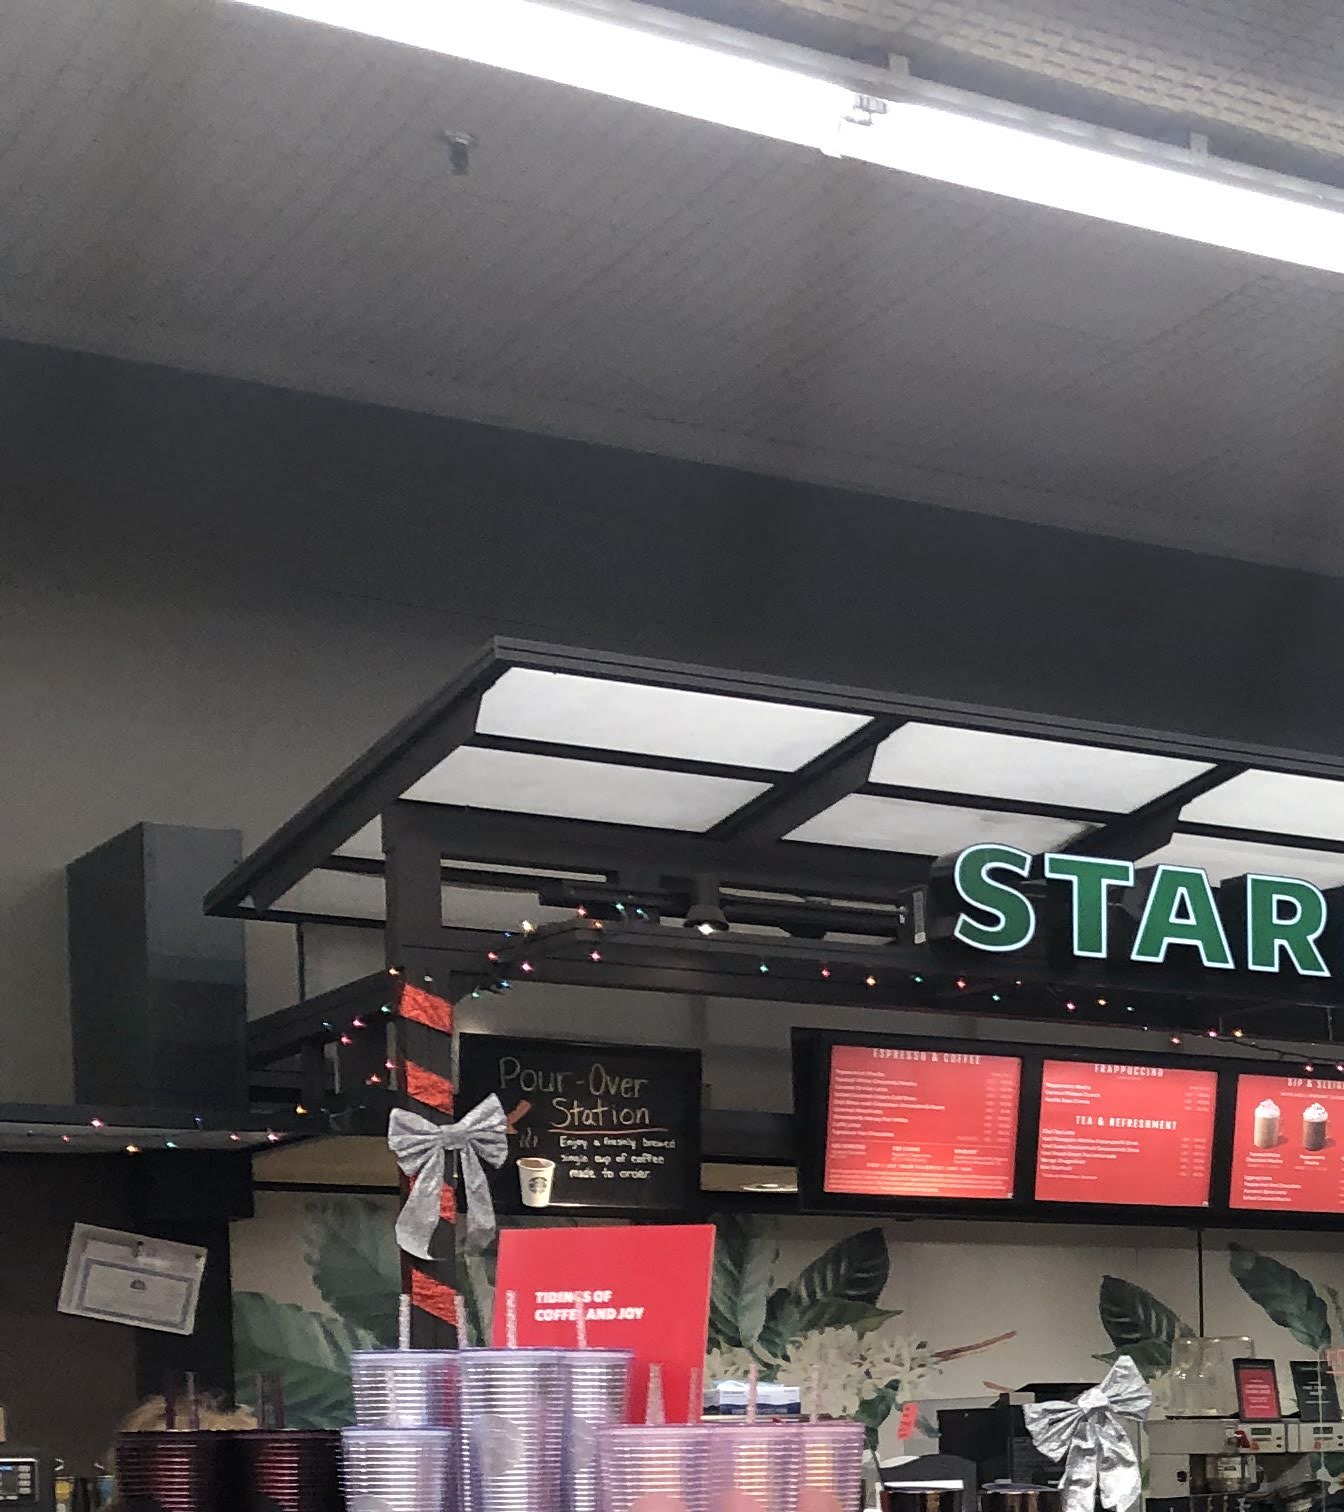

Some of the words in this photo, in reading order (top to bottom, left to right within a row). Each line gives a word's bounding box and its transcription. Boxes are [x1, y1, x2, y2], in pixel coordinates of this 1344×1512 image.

[873, 1048, 927, 1061] ESPRESSO
[943, 1053, 982, 1065] COFFEE
[1094, 1064, 1164, 1077] FRAPPUCCINO
[1287, 1078, 1303, 1087] SIP
[552, 1097, 651, 1128] Station
[1075, 1115, 1093, 1125] TEA
[1097, 1116, 1105, 1126] &
[1109, 1117, 1177, 1130] REFRESHMENT
[559, 1136, 588, 1150] Enjoy
[595, 1154, 612, 1165] cup
[616, 1152, 627, 1163] of
[631, 1152, 665, 1165] coffee
[569, 1167, 596, 1179] made
[601, 1167, 614, 1179] to
[619, 1168, 651, 1179] order
[535, 1291, 591, 1303] TIDINGS
[593, 1290, 613, 1303] OF
[534, 1308, 585, 1321] COFFE
[586, 1307, 616, 1320] AND
[618, 1307, 645, 1320] JOY
